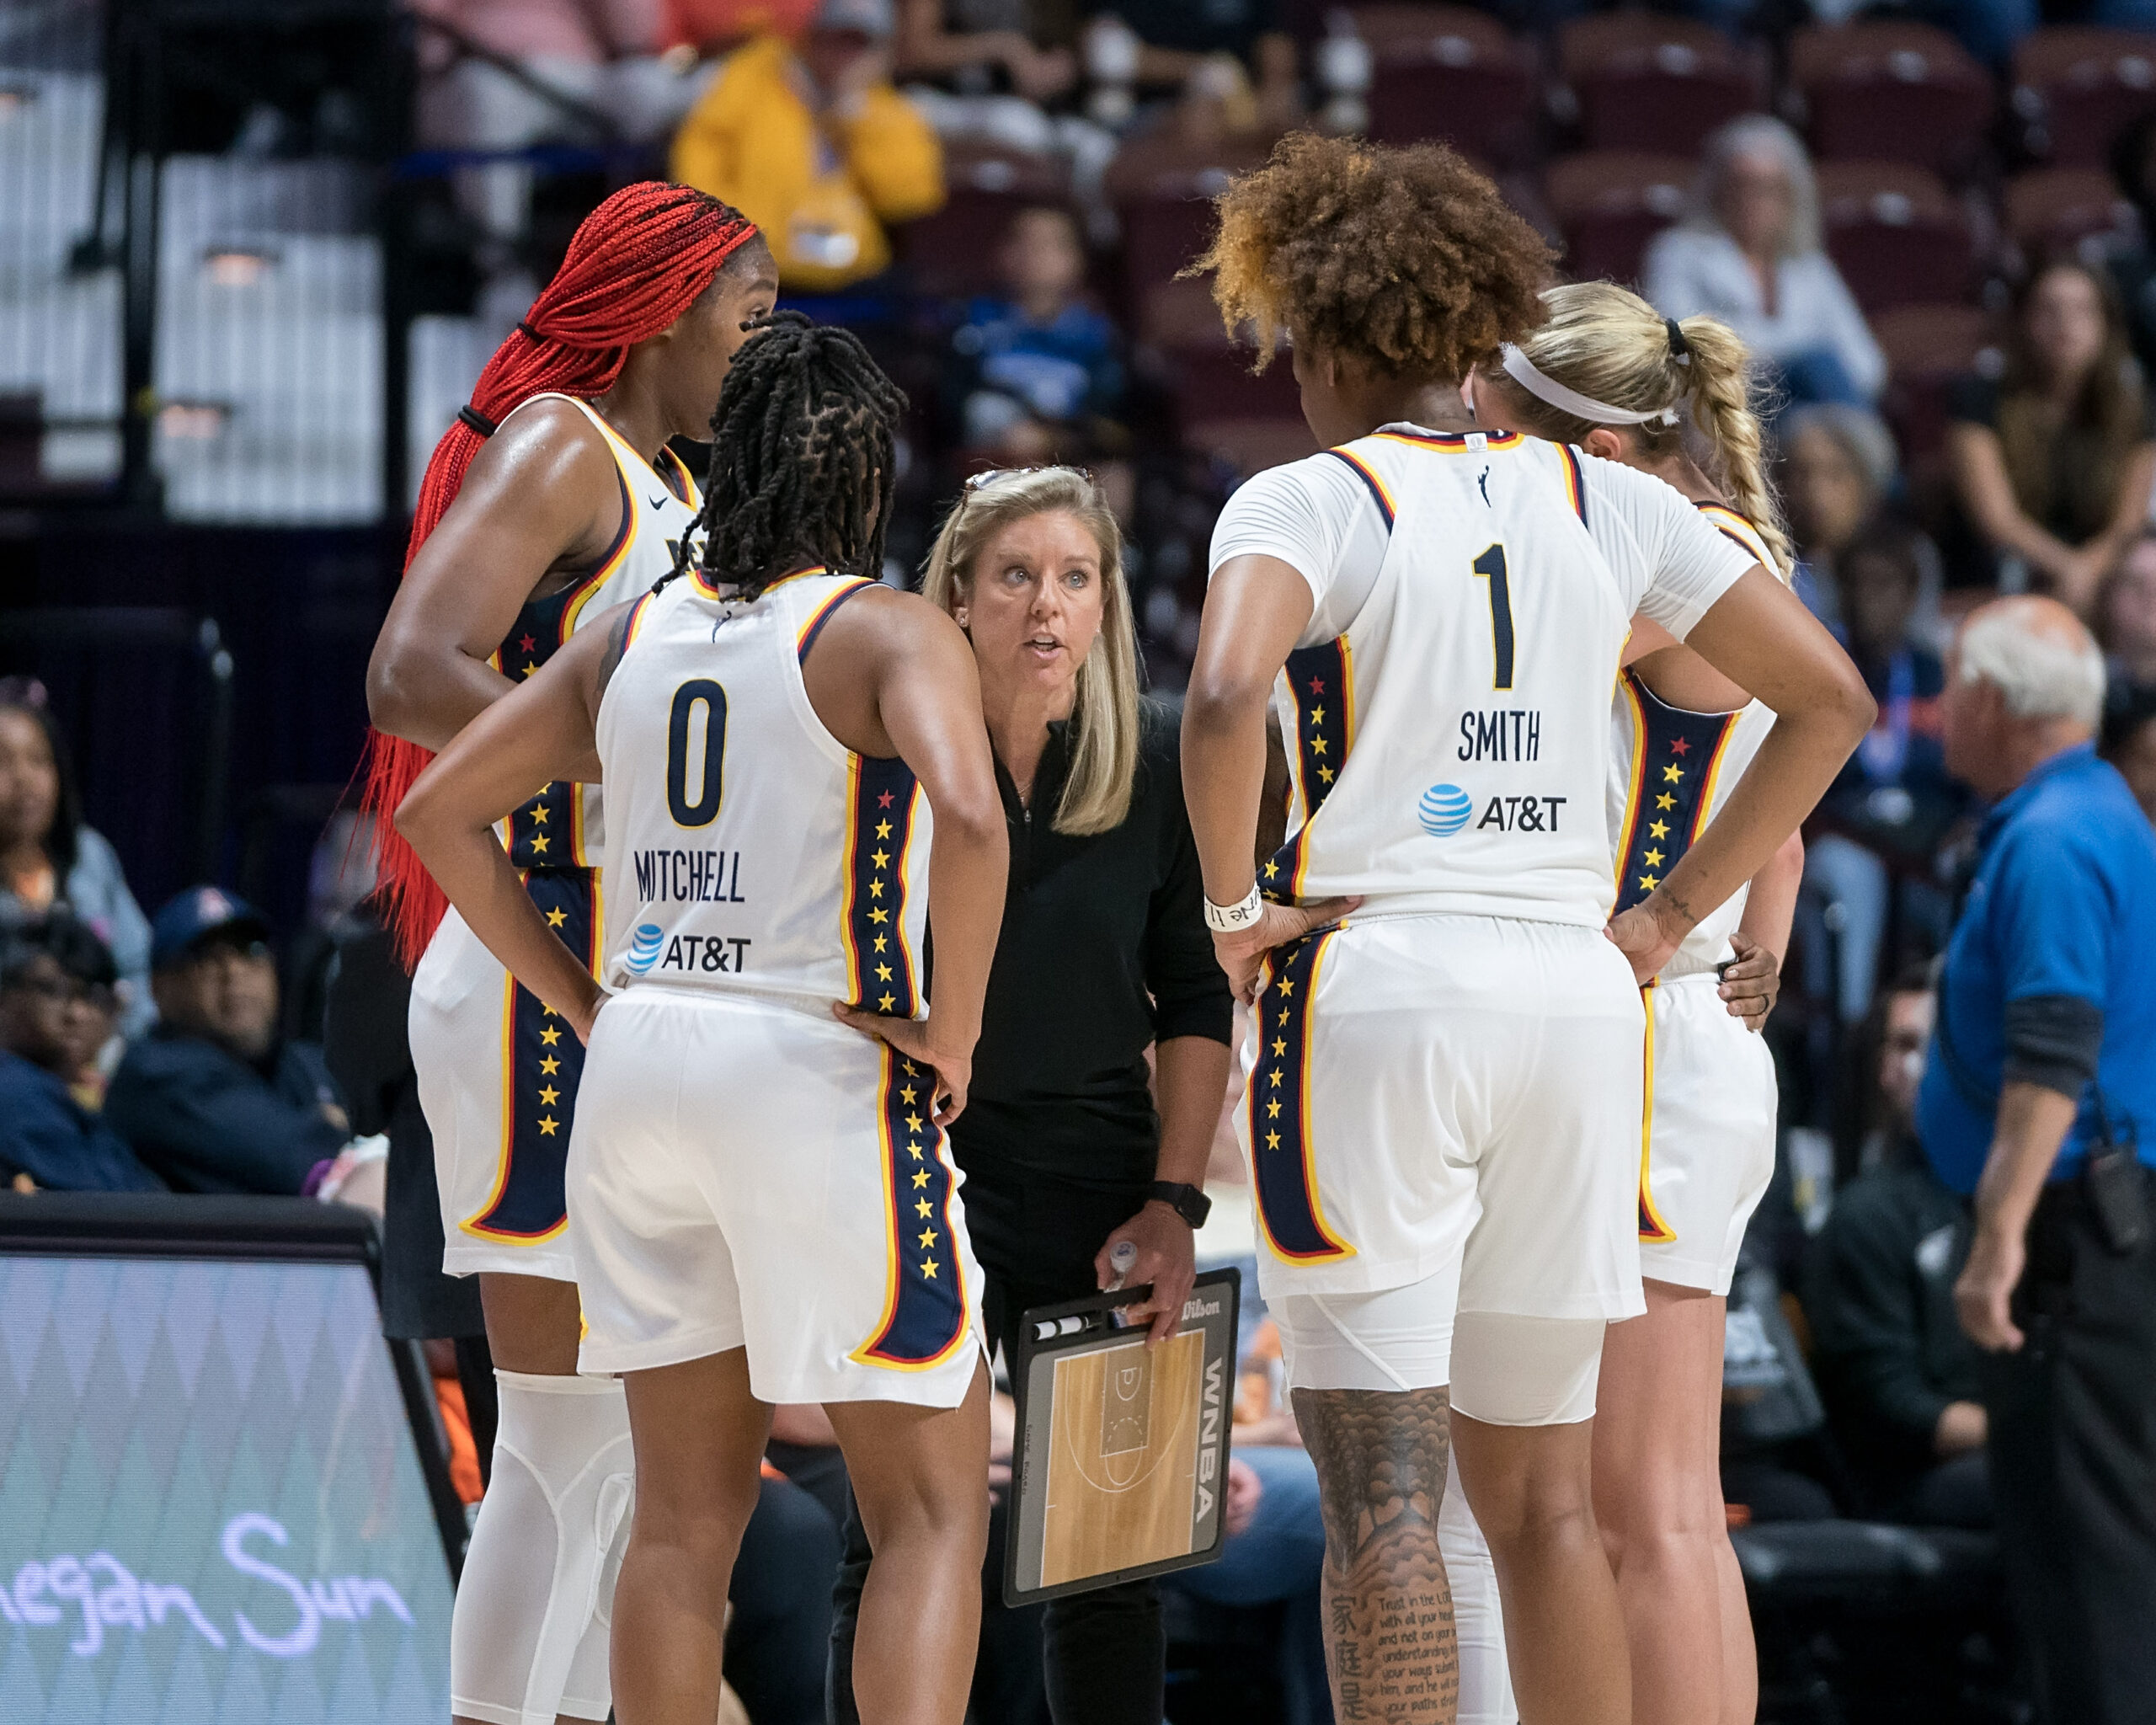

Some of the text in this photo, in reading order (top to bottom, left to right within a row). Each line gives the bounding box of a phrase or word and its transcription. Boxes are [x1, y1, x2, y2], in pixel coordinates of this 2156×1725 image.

[1470, 543, 1515, 691] 1
[665, 678, 729, 830] 0
[1458, 710, 1540, 762] SMITH
[1477, 796, 1566, 832] AT&T
[634, 850, 745, 903] MITCHELL
[661, 935, 751, 973] AT&T
[1196, 1357, 1222, 1524] WNBA
[220, 1513, 418, 1658] Sun
[1377, 1597, 1406, 1611] Trust
[1409, 1598, 1418, 1607] in
[1419, 1594, 1435, 1606] the
[1379, 1632, 1397, 1646] and
[1401, 1630, 1418, 1643] not
[1422, 1631, 1433, 1641] on
[1380, 1615, 1402, 1628] with
[1418, 1612, 1437, 1627] your
[1382, 1668, 1405, 1682] your
[1409, 1666, 1432, 1680] ways
[1405, 1682, 1424, 1695] and
[1427, 1680, 1438, 1693] he
[1385, 1701, 1407, 1717] your
[1412, 1697, 1438, 1713] paths
